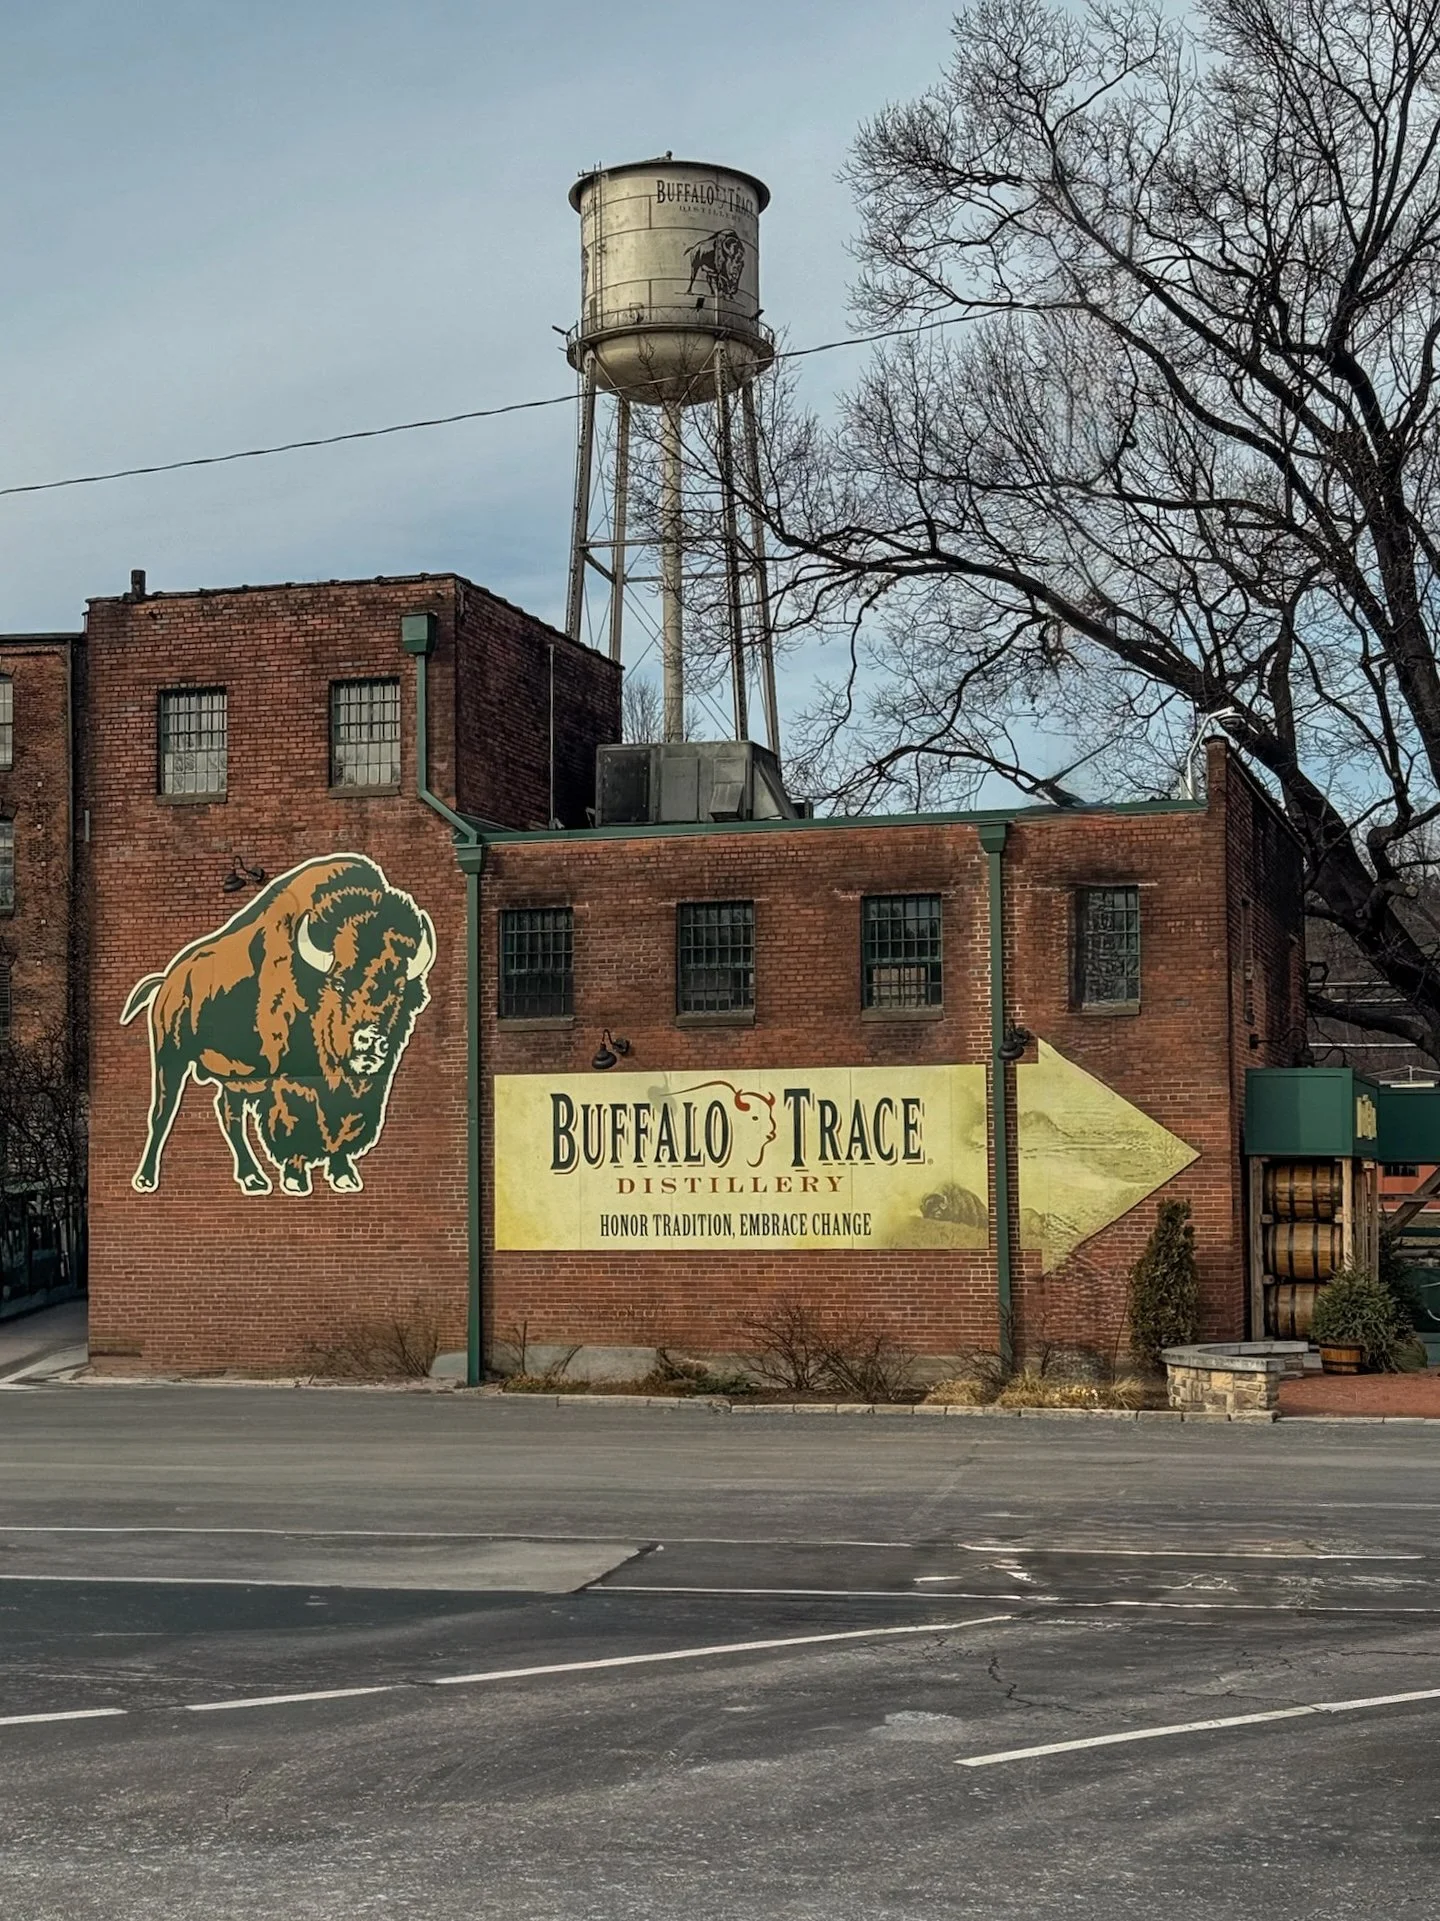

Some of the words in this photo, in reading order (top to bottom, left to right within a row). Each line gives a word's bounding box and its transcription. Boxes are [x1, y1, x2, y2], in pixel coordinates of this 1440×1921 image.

[656, 179, 714, 206] BUFFALO
[551, 1093, 734, 1174] BUFFALO
[783, 1088, 927, 1172] TRACE
[616, 1176, 845, 1195] DISTILLERY
[600, 1213, 649, 1237] HONOR
[652, 1213, 736, 1240] TRADITION,
[739, 1212, 808, 1237] EMBRACE
[812, 1212, 872, 1237] CHANGE
